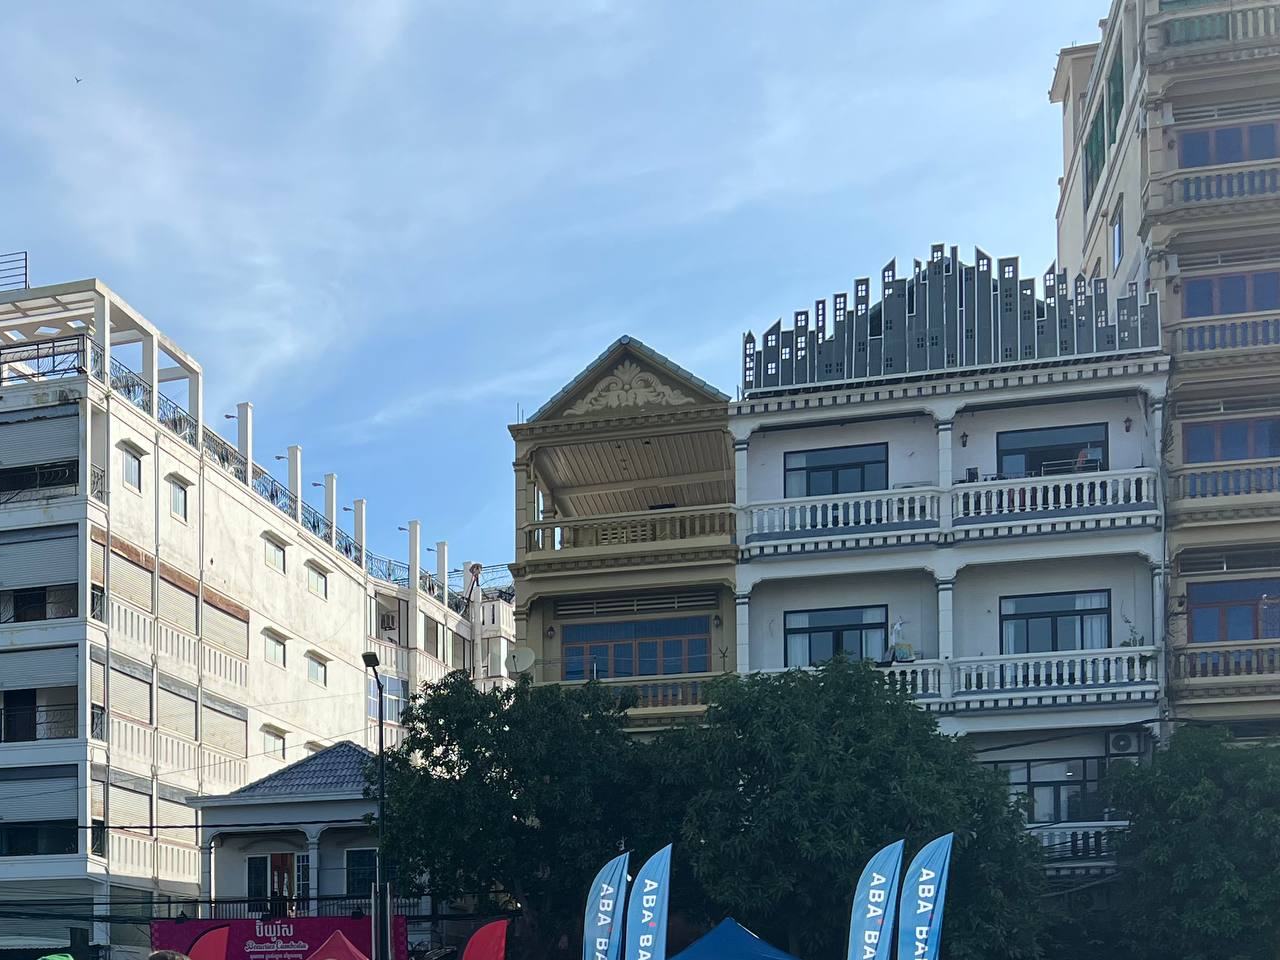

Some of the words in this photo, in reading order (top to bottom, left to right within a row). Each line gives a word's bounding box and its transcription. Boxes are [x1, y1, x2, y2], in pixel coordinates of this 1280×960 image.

[597, 883, 614, 926] ABA
[641, 879, 658, 923] ABA
[866, 872, 886, 919] ABA
[916, 868, 935, 914] ABA
